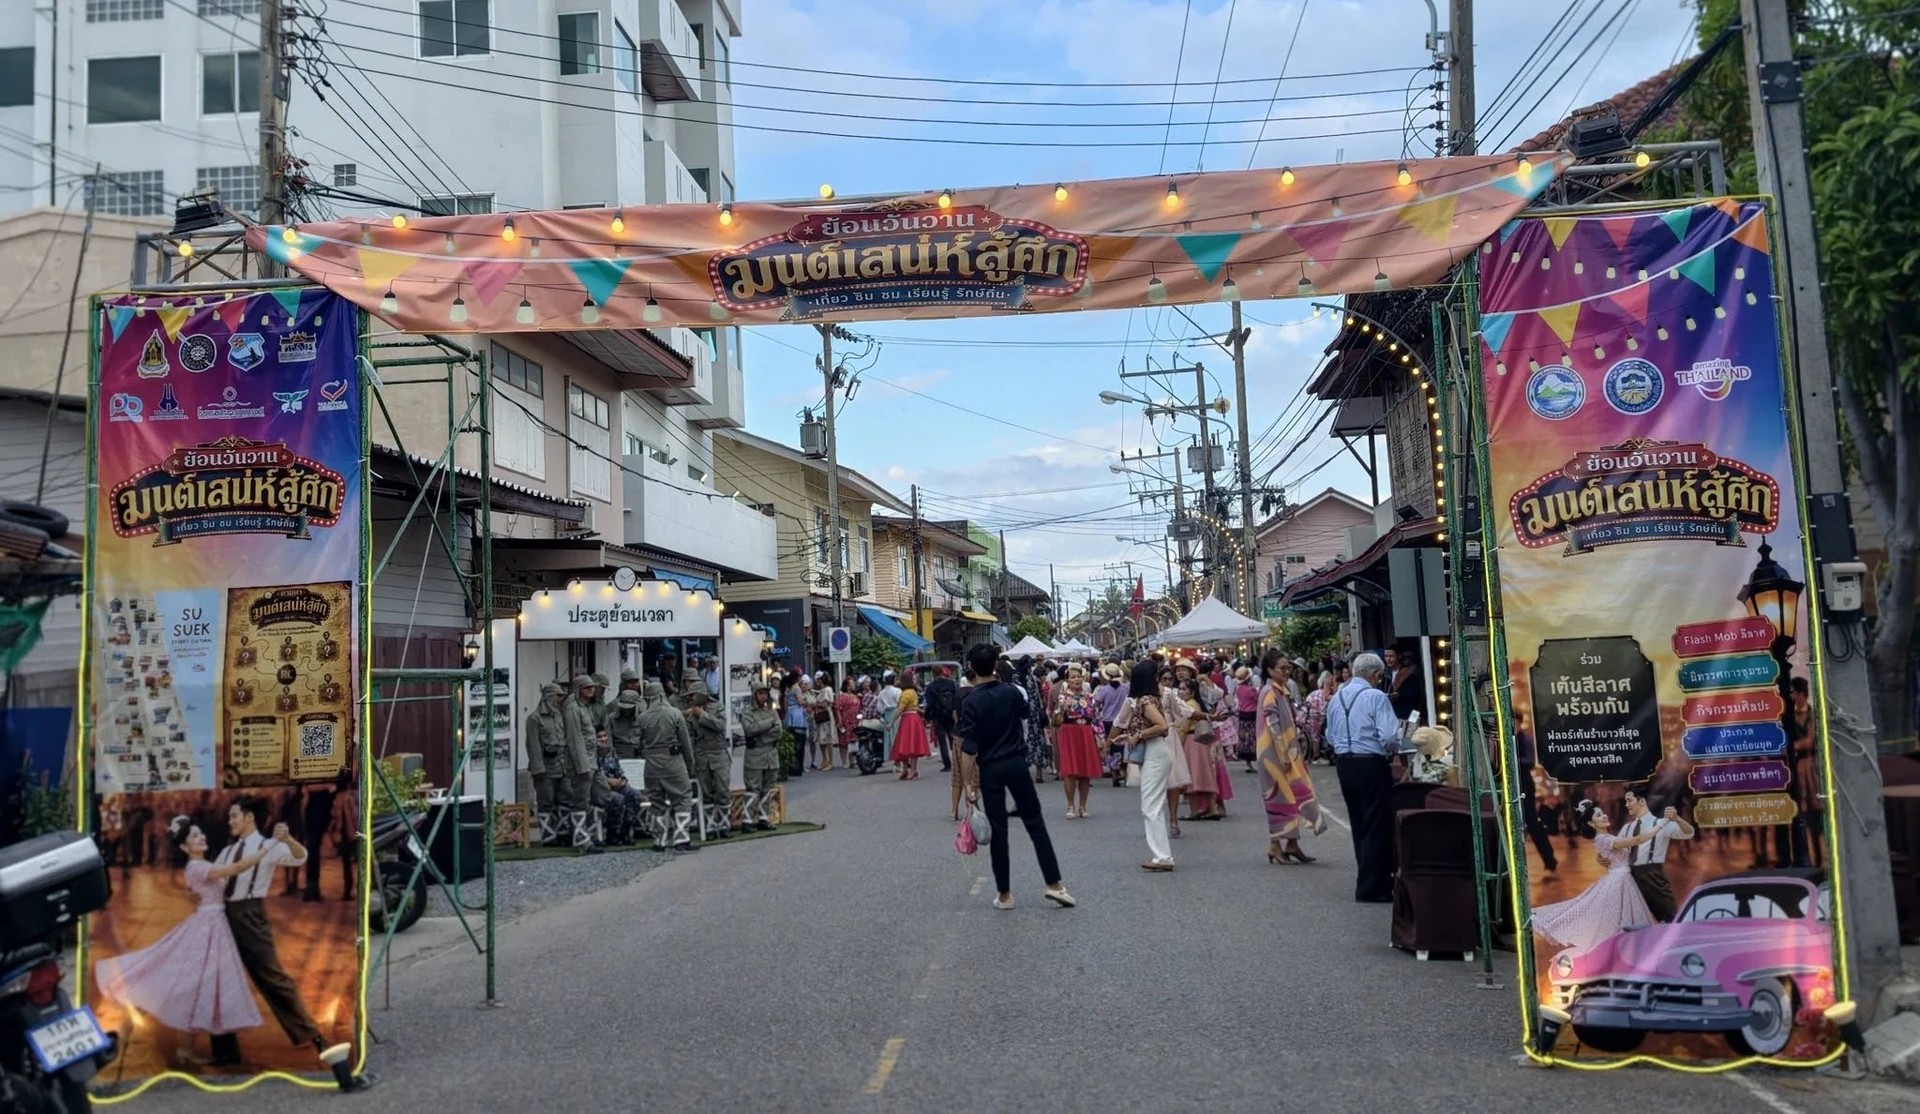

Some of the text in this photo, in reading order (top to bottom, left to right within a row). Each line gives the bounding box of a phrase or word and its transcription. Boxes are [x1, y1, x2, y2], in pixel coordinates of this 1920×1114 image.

[822, 212, 975, 237] ย้อนวันวาน
[725, 230, 1079, 299] มนต์เสน่ห์สู้ศึก
[815, 292, 848, 306] เที่ยว
[908, 285, 950, 302] เรียนรู้
[1694, 359, 1730, 370] amazing
[1676, 367, 1750, 385] THAILAND
[184, 449, 278, 467] ย้อนวันวาน
[1587, 451, 1697, 472] ย้อนวันวาน
[120, 467, 338, 525] มนต์เสน่ห์สู้ศึก
[1522, 467, 1774, 536] มนต์เสน่ห์สู้ศึก
[182, 608, 202, 621] SU
[568, 602, 674, 629] ประตูย้อนเวลา
[173, 623, 210, 637] SUEK
[1683, 634, 1711, 646] Flash
[1714, 630, 1738, 642] Mob
[1580, 652, 1602, 665] ร่วม
[1556, 696, 1630, 716] พร้อมกัน
[1695, 699, 1770, 717] กิจกรรมศิลปะ
